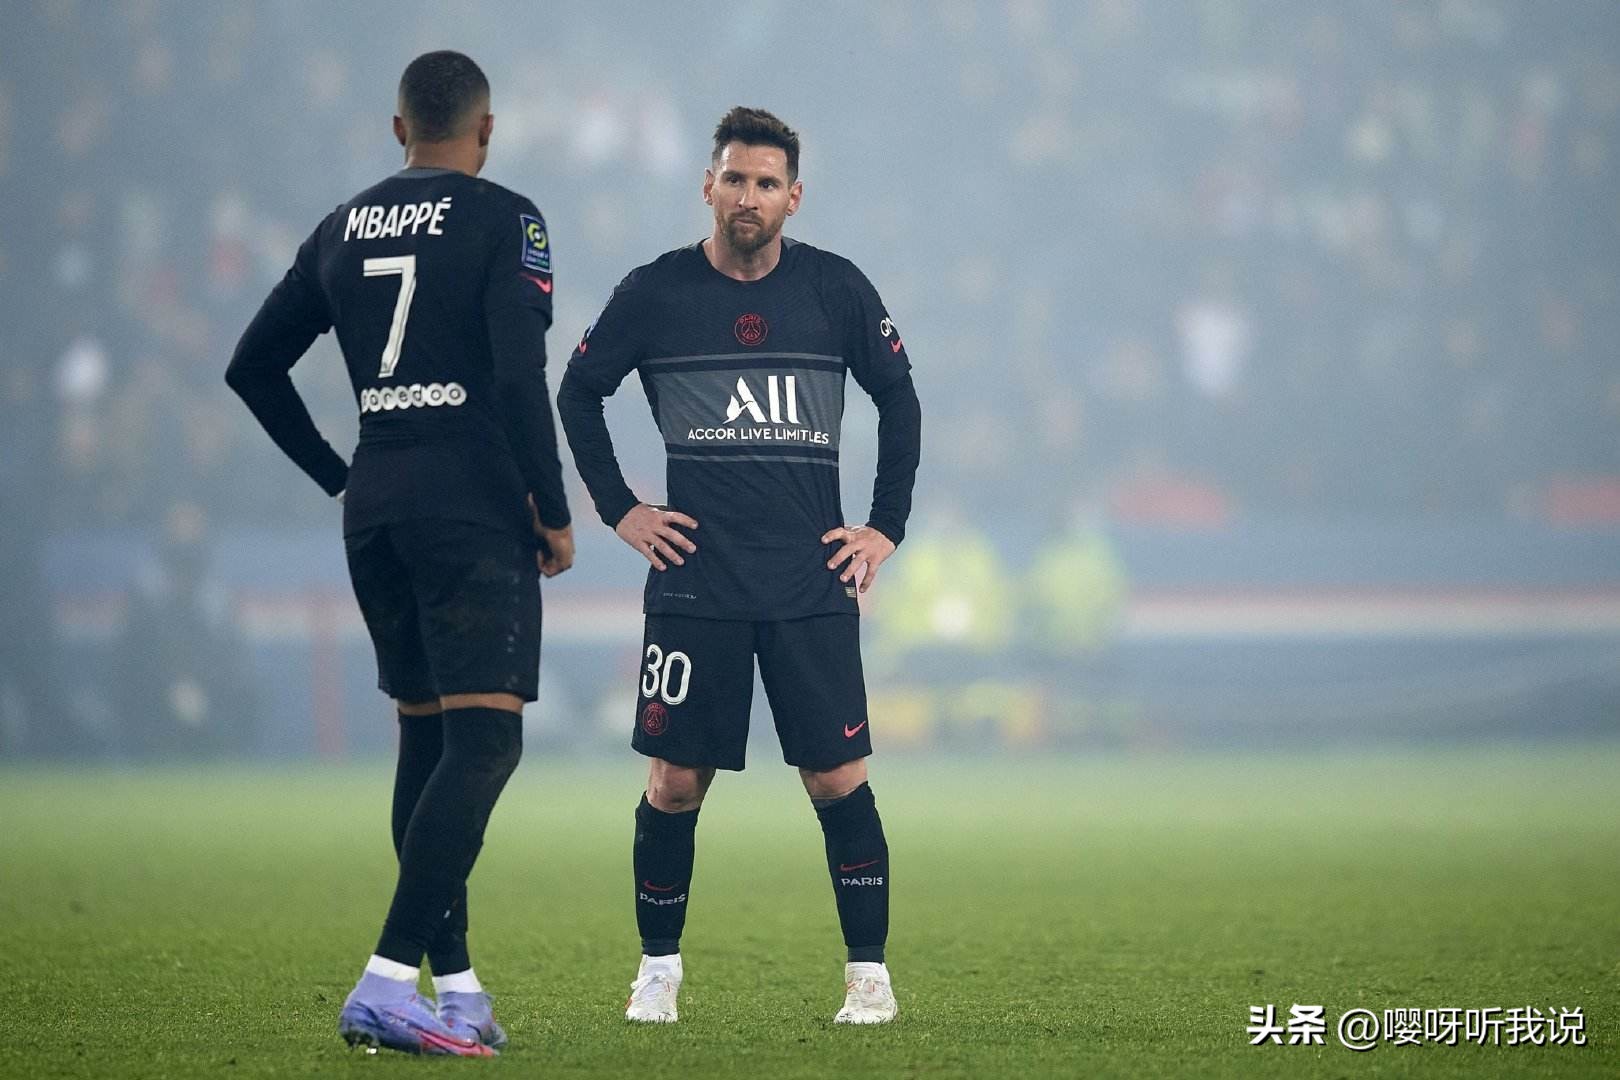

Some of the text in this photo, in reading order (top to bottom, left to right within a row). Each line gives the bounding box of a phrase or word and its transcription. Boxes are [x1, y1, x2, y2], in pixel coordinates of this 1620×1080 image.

[343, 197, 452, 242] MBAPPÉ
[363, 254, 417, 378] 7
[687, 428, 737, 440] ACCOR
[740, 428, 772, 440] LIVE
[641, 643, 692, 705] 30
[840, 876, 884, 887] PARIS
